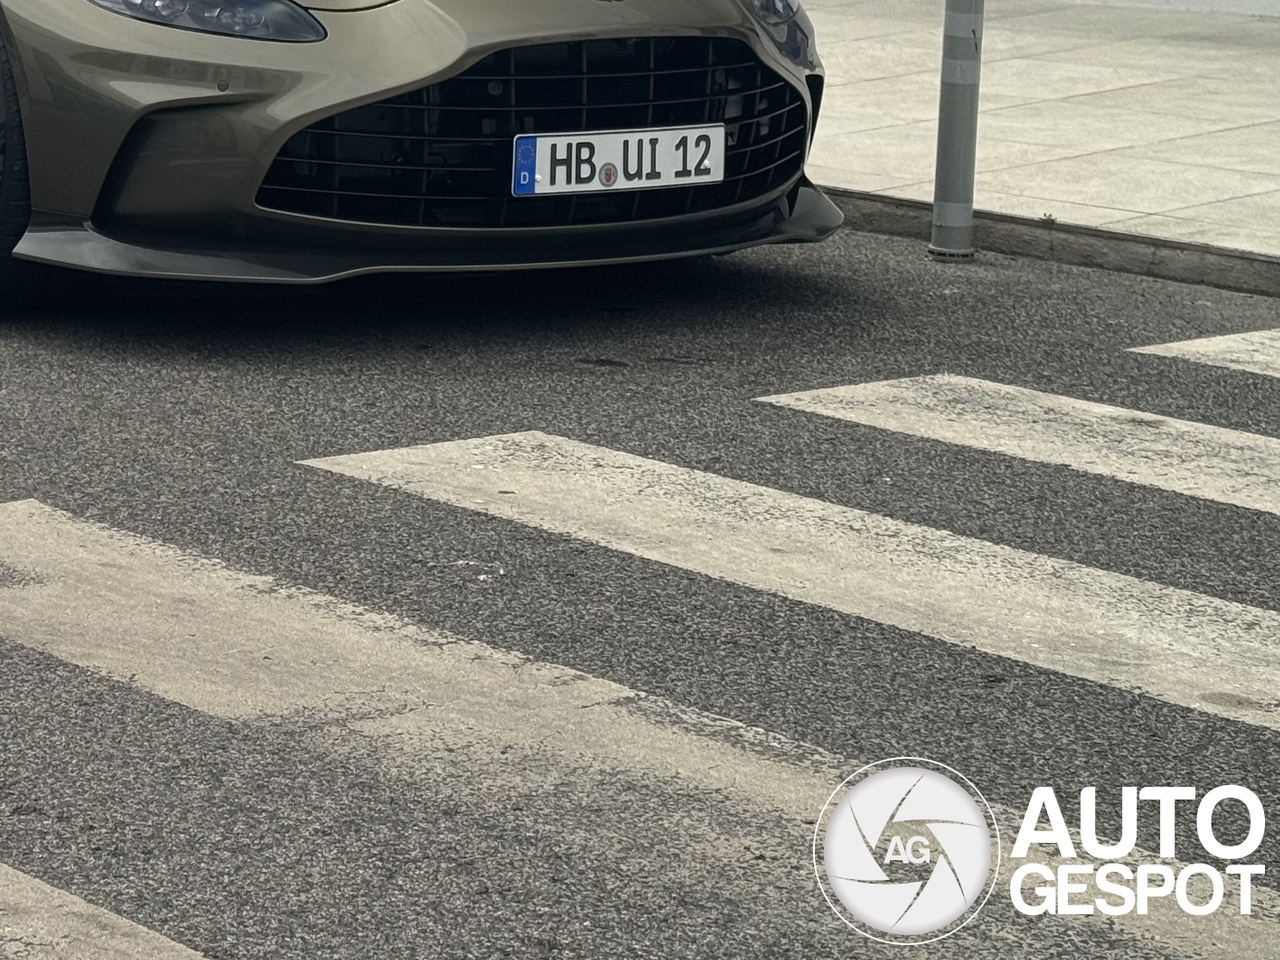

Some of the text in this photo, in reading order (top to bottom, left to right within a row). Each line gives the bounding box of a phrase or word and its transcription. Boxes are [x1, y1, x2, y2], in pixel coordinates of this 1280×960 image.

[550, 135, 711, 186] HB UI 12
[521, 172, 529, 184] D
